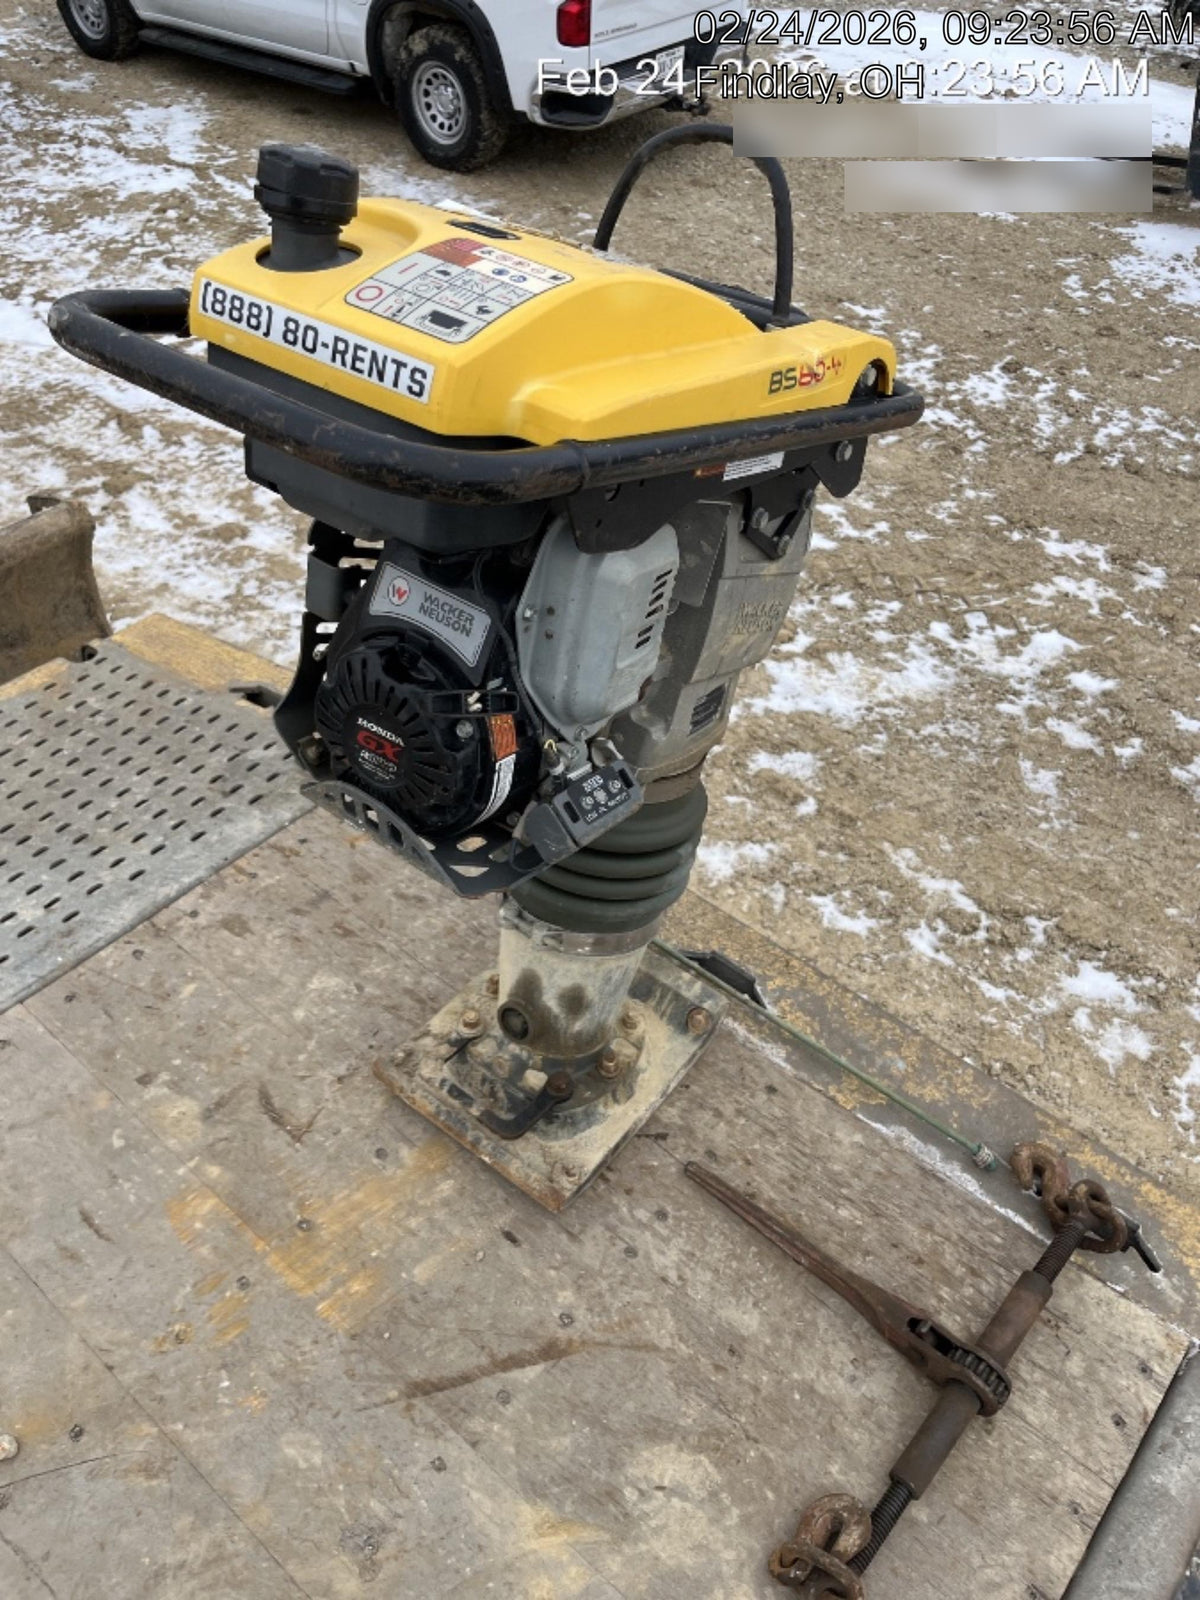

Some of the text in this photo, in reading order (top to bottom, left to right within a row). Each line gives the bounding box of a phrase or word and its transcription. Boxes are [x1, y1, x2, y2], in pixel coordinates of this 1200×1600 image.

[202, 281, 428, 400] (888) 80-RENTS
[418, 602, 473, 638] NEUSON
[424, 591, 475, 627] WACKER
[357, 717, 405, 748] HONDA
[357, 729, 402, 764] GX
